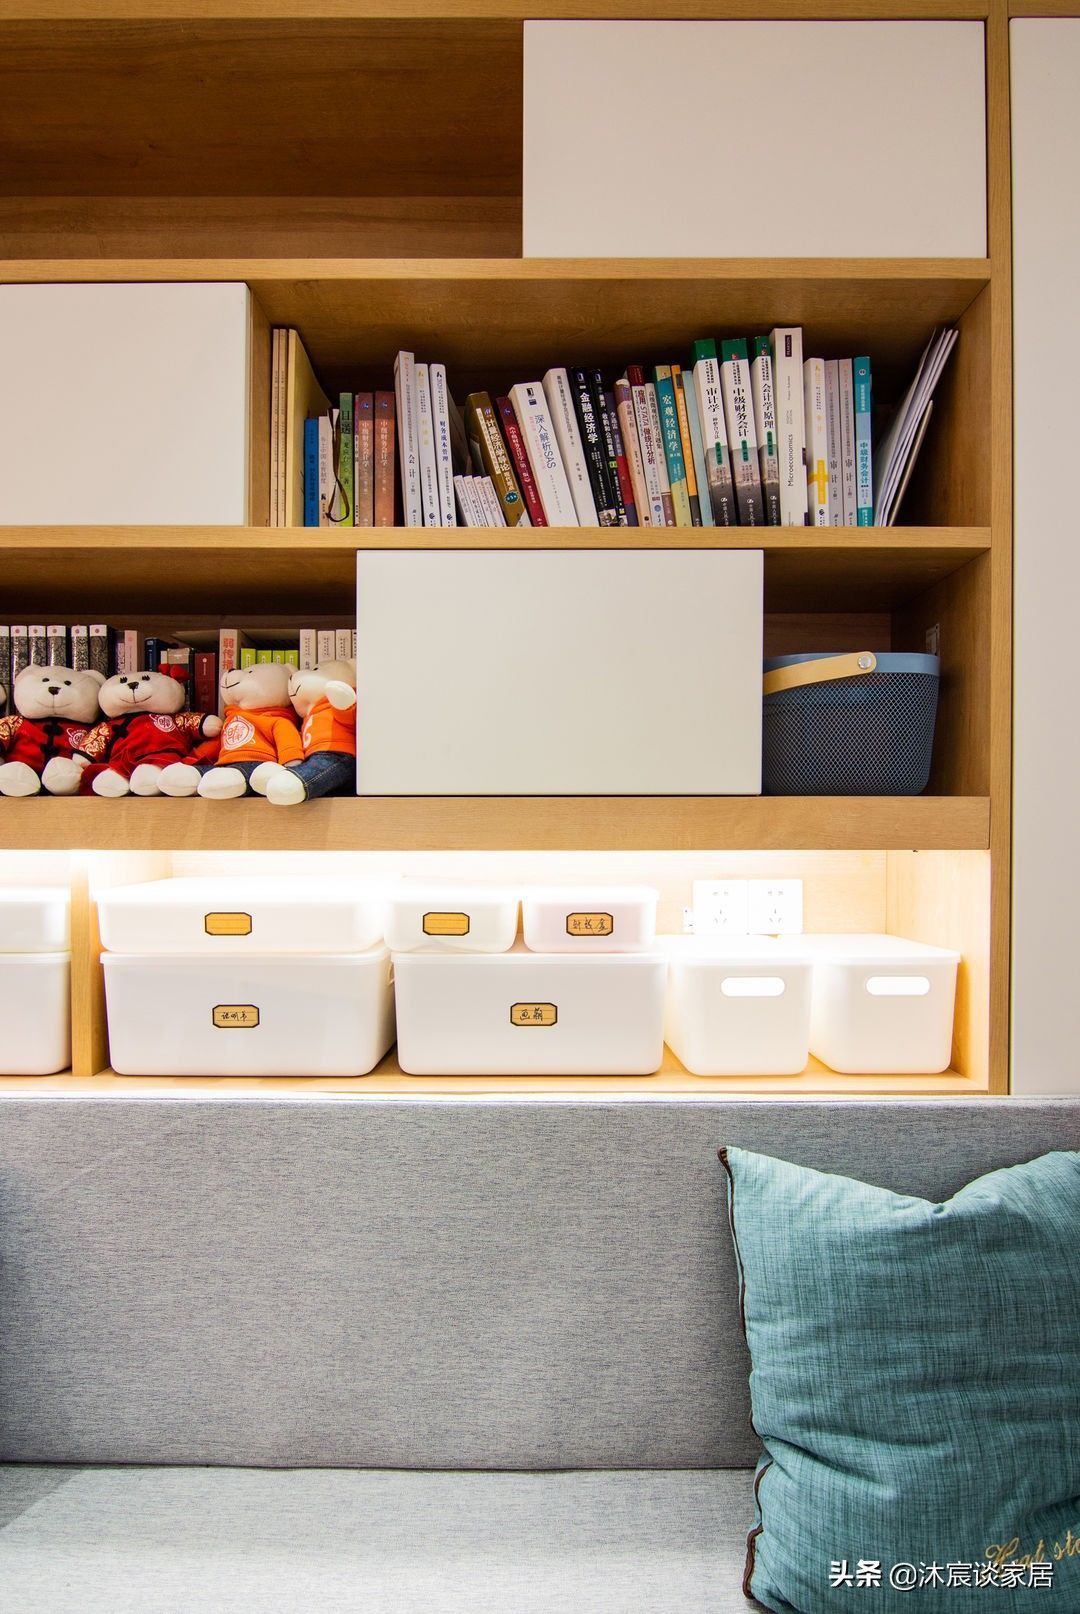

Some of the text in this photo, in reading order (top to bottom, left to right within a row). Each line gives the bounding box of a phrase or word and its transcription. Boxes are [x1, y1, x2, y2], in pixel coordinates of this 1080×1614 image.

[341, 411, 352, 434] 目送
[579, 392, 599, 444] 金融经济学
[662, 394, 680, 451] 宏观经济学
[706, 387, 720, 413] 审计学
[733, 387, 749, 437] 中级财务会计
[762, 383, 775, 429] 会计学原理
[440, 421, 449, 462] 财务成本管理
[535, 414, 557, 469] 深入解析SAS
[860, 442, 869, 485] 中级财务会计
